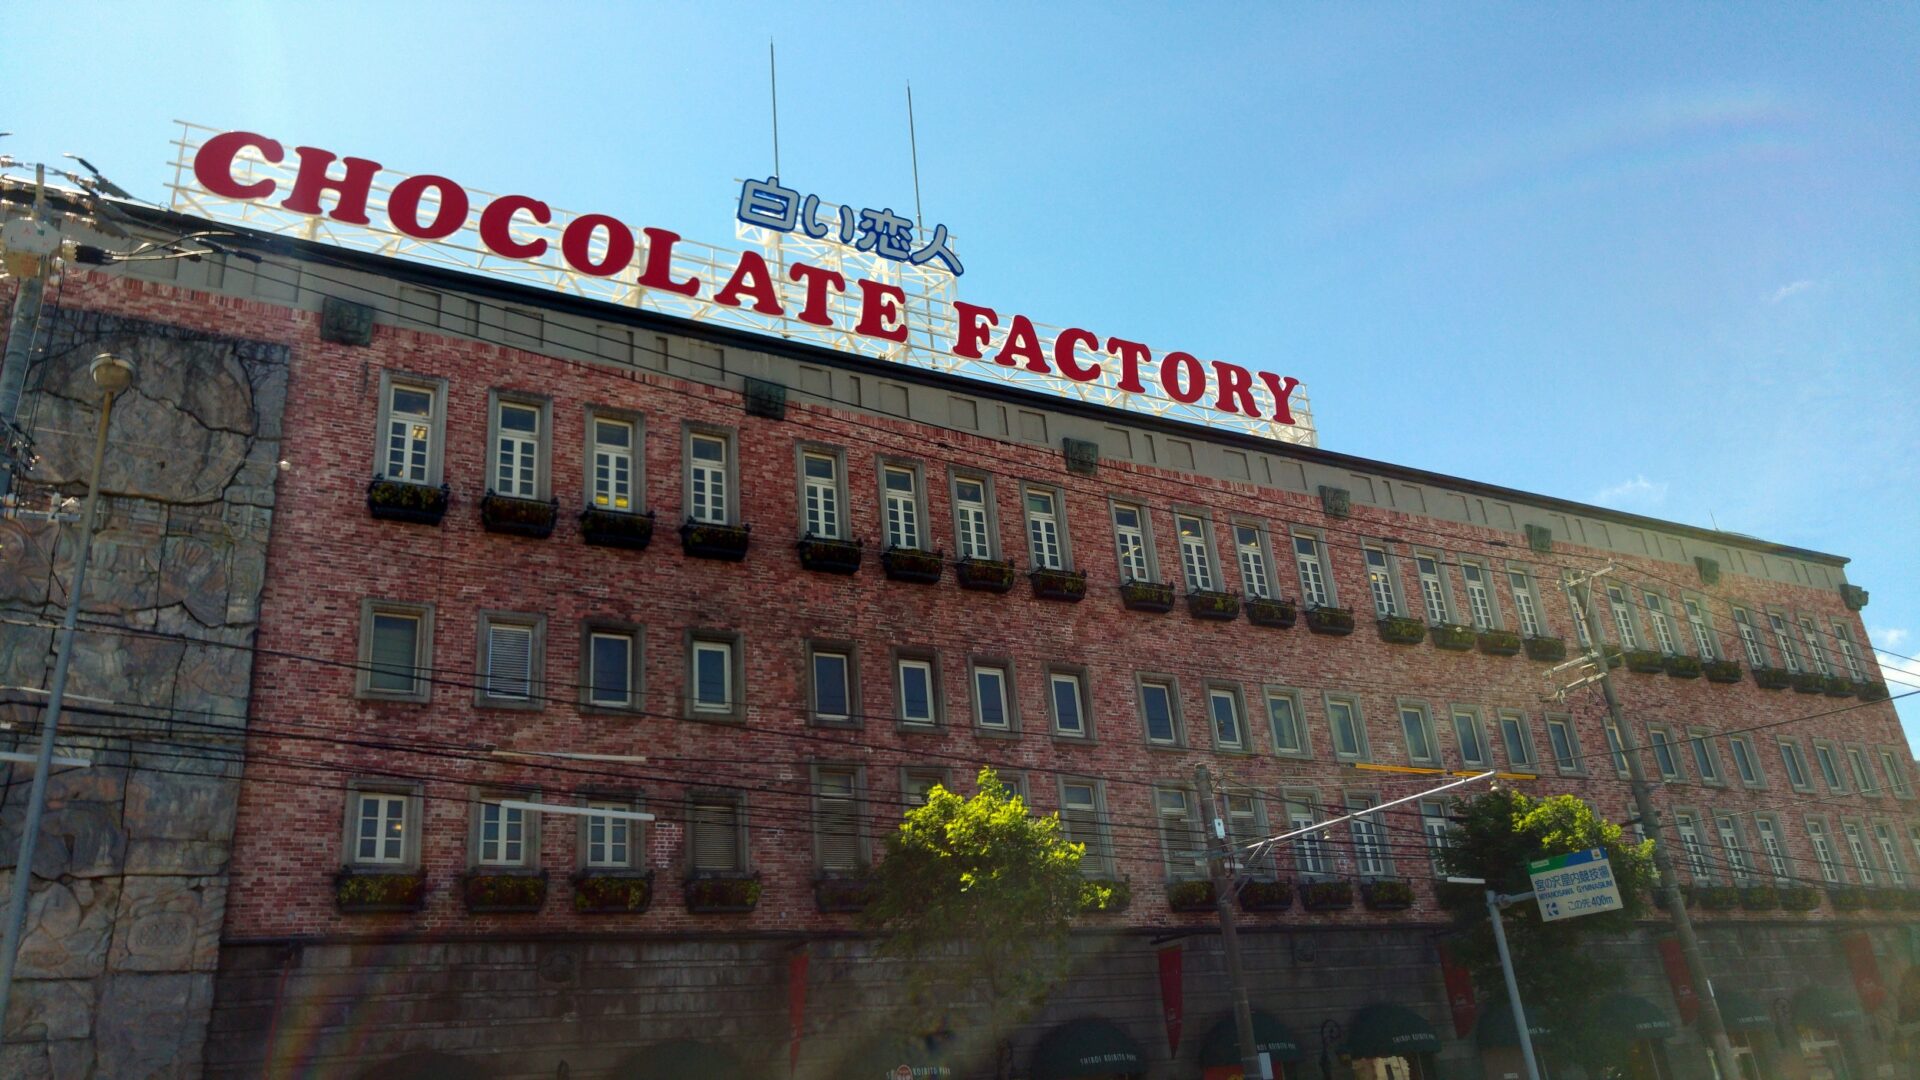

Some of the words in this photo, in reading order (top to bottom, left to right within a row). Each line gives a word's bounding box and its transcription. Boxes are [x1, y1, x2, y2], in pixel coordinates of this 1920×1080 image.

[737, 176, 965, 277] 白い恋人
[193, 130, 909, 344] CHOCOLATE
[952, 300, 1300, 426] FACTORY
[1538, 888, 1575, 900] MIYANOSAWA
[1576, 880, 1613, 893] GYMNASIUM
